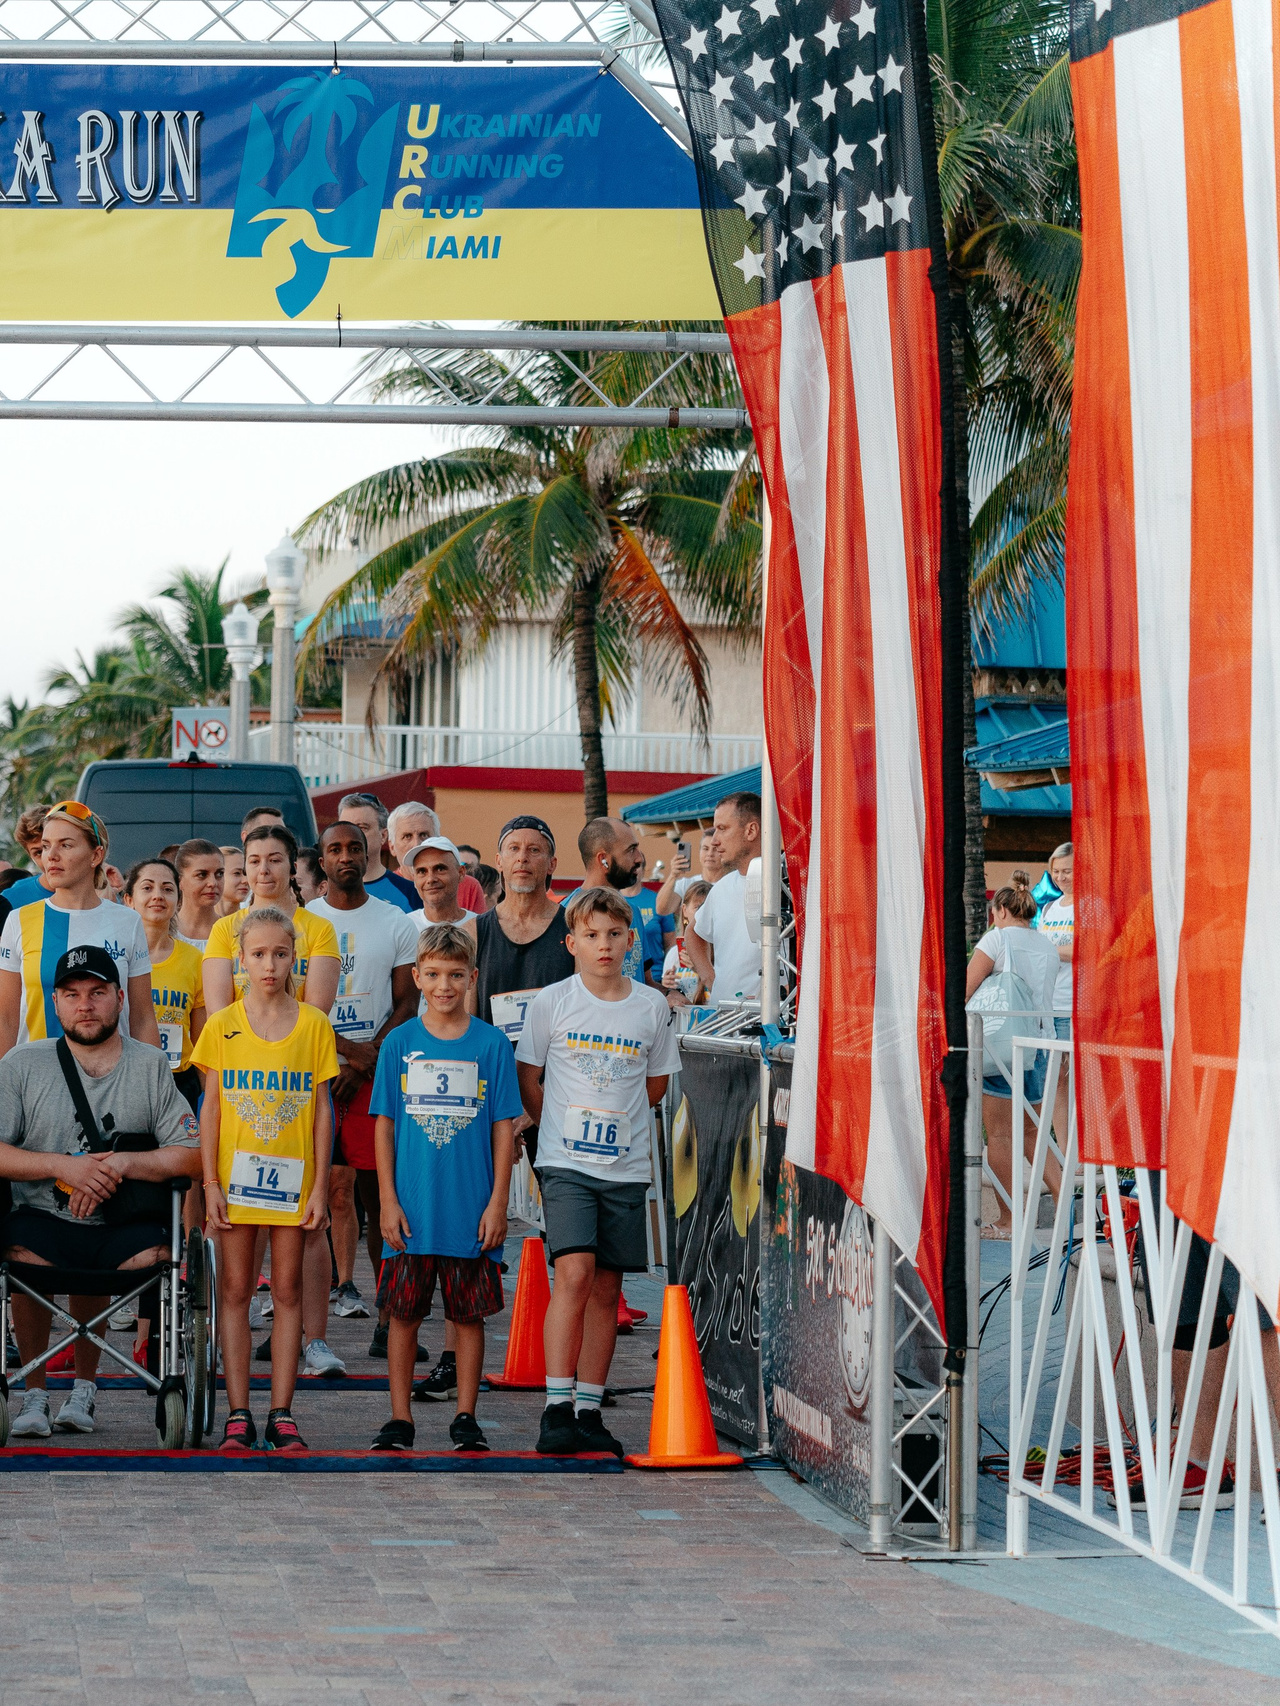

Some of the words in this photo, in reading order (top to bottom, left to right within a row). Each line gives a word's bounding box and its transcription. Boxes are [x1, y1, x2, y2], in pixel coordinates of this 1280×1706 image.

[407, 103, 602, 138] UKRAINIAN
[75, 109, 202, 212] RUN
[398, 144, 565, 179] RUNNING
[392, 184, 485, 220] CLUB
[336, 1004, 357, 1023] 44
[566, 1031, 642, 1057] UKRAINE
[222, 1065, 313, 1092] UKRAINE
[436, 1073, 449, 1095] 3
[582, 1120, 618, 1145] 116
[256, 1166, 280, 1190] 14
